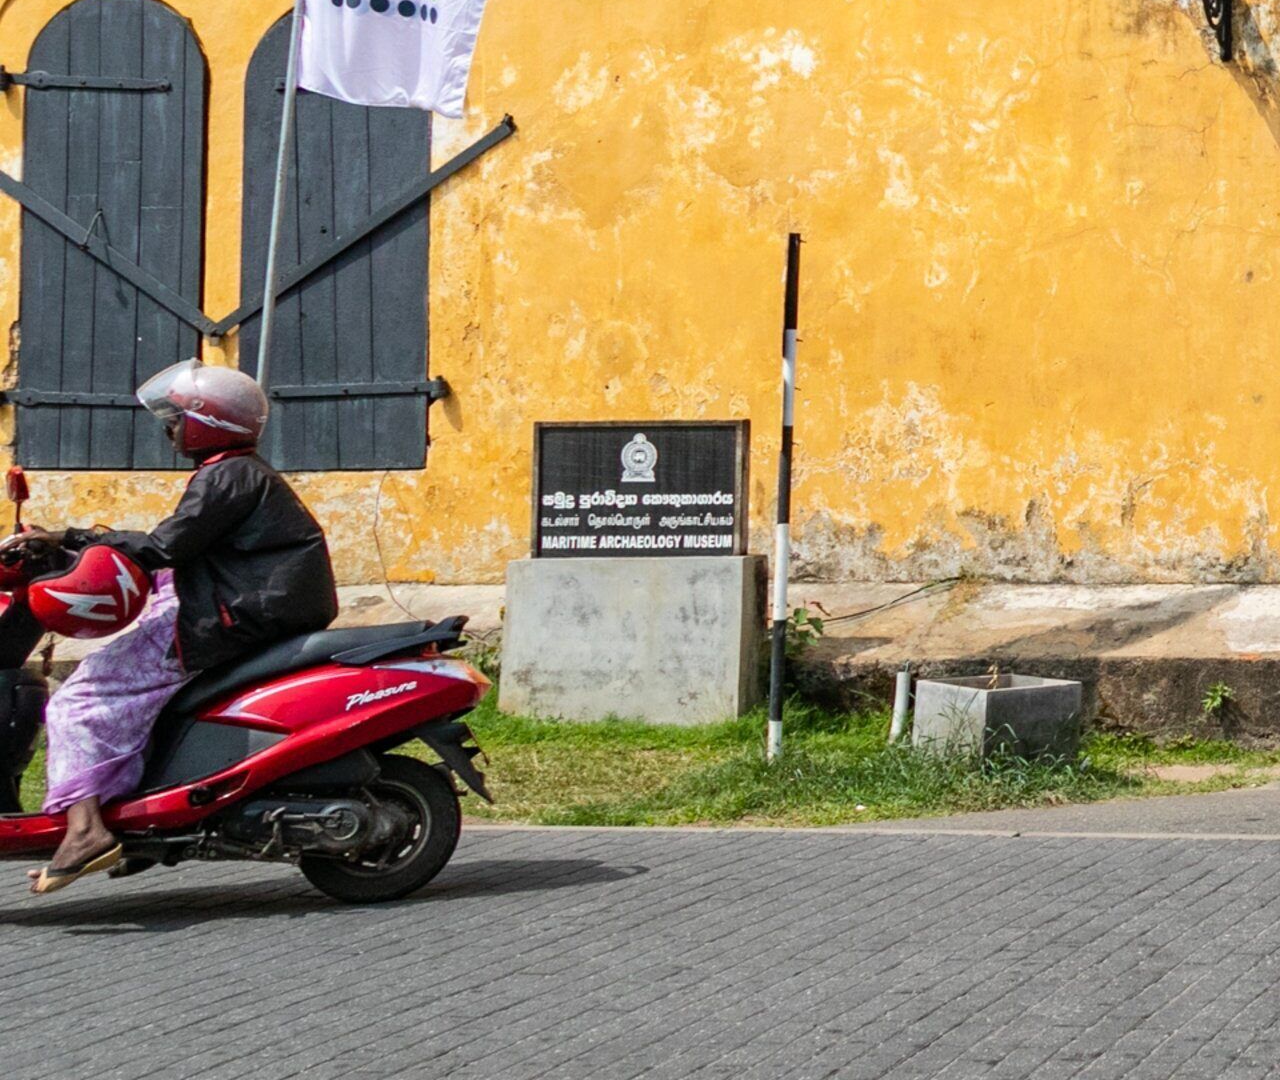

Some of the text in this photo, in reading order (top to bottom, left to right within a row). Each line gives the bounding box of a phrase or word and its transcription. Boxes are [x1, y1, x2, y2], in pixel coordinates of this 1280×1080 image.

[542, 534, 733, 549] MARITIME ARCHAEOLOGY MUSEUM
[345, 681, 418, 711] Pleasure
